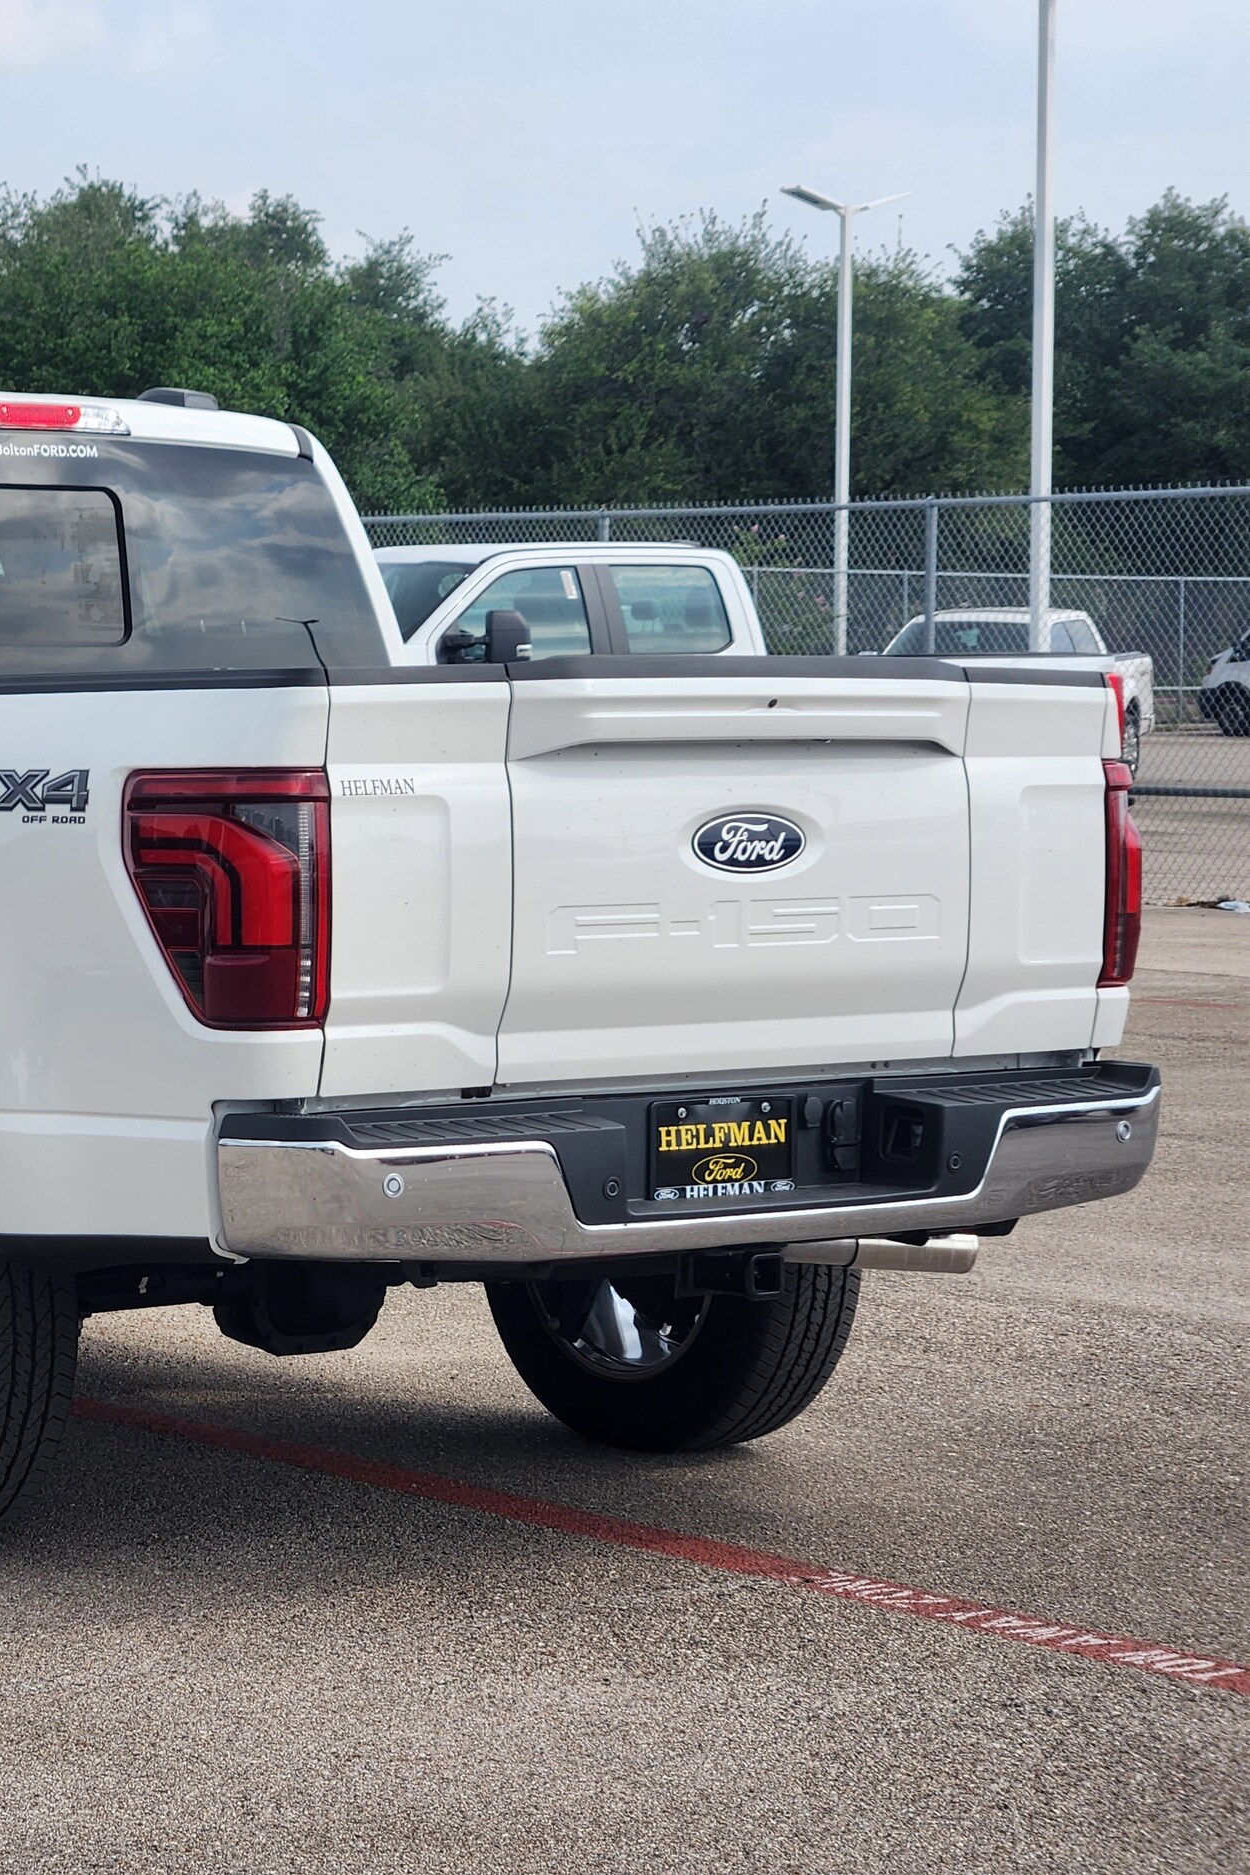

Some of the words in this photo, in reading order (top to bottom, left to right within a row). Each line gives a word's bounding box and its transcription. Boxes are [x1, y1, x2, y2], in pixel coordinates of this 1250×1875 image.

[340, 778, 416, 797] HELFMAN
[21, 814, 48, 824] OFF
[51, 815, 87, 825] ROAD
[713, 821, 786, 862] Ford
[545, 892, 942, 956] F-150
[708, 1096, 742, 1106] HOUSTON
[658, 1118, 788, 1152] HELFMAN
[704, 1157, 746, 1182] Ford
